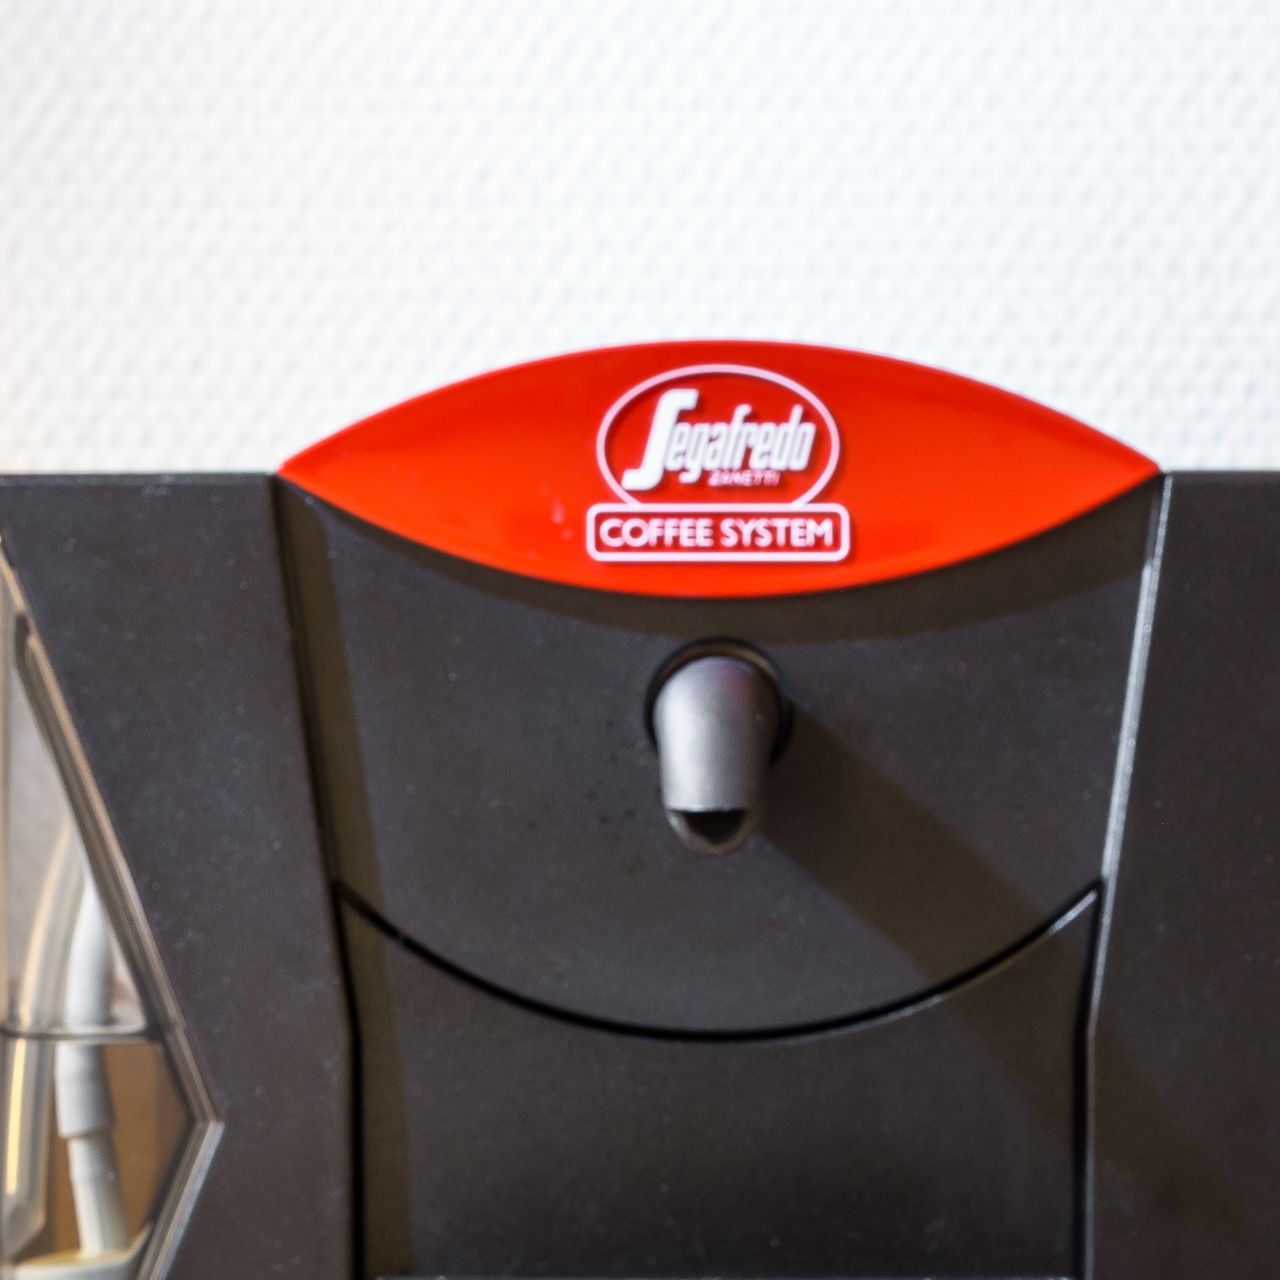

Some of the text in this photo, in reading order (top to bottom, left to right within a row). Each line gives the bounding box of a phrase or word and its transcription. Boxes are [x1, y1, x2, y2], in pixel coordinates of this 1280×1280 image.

[621, 387, 816, 490] Segafredo
[599, 518, 833, 547] COFFEE SYSTEM
